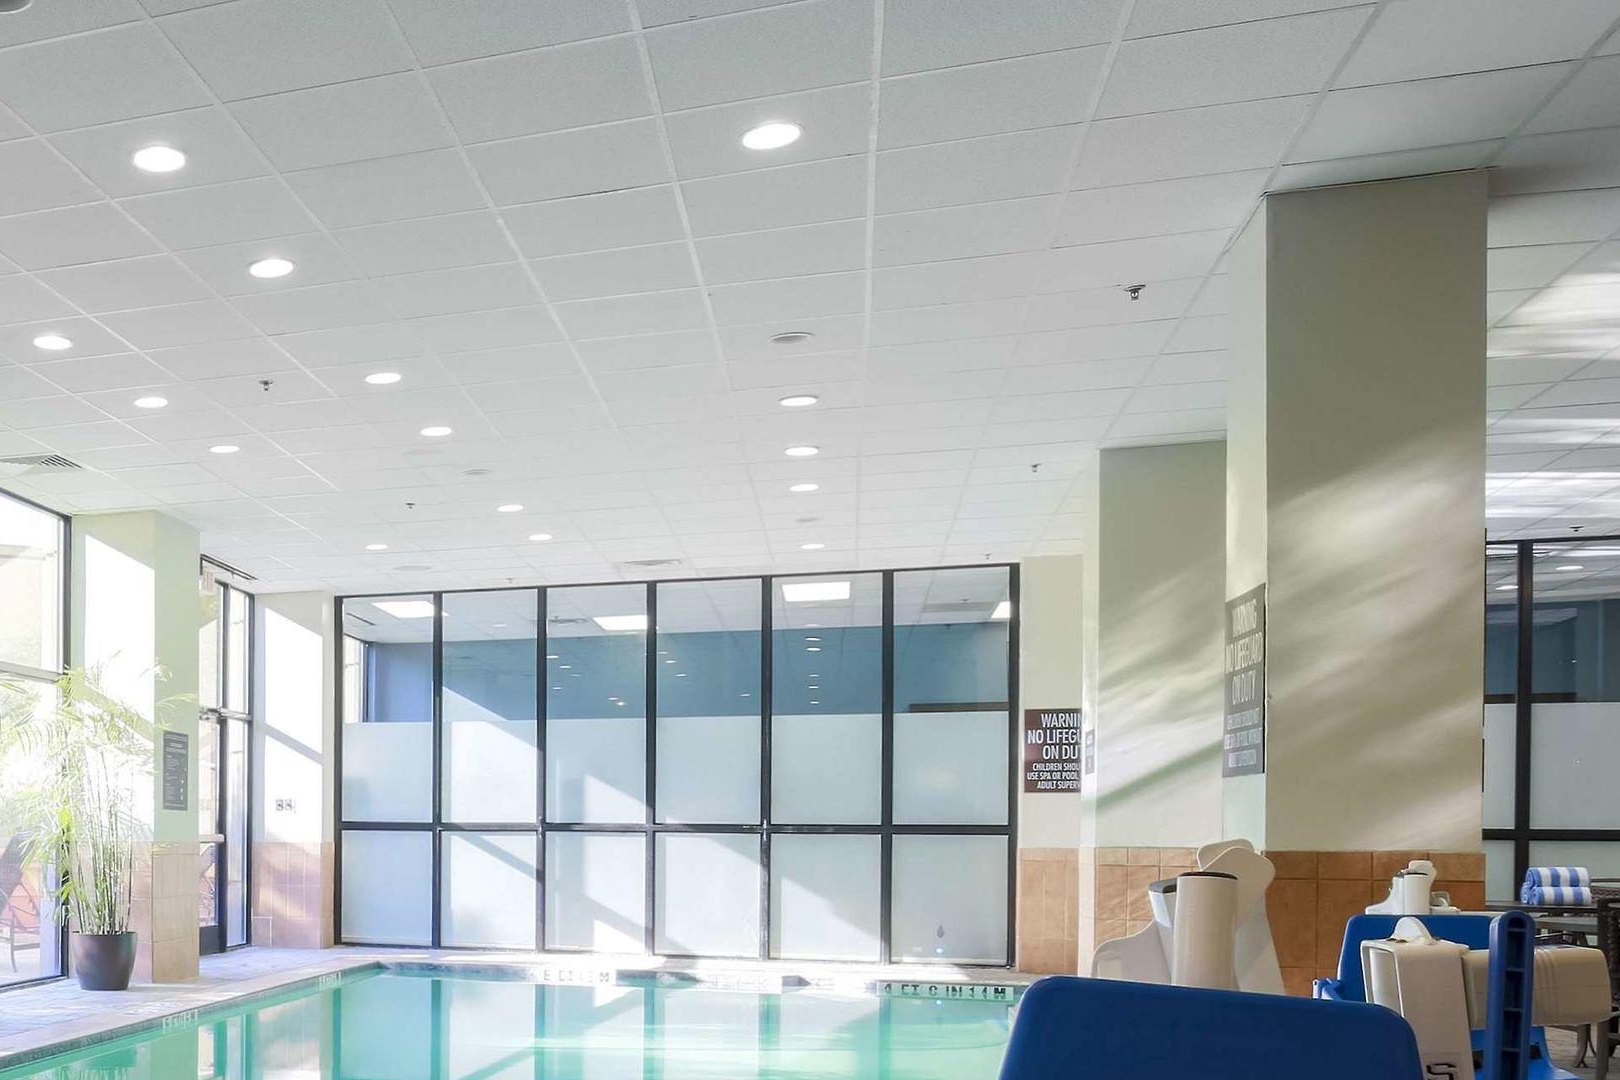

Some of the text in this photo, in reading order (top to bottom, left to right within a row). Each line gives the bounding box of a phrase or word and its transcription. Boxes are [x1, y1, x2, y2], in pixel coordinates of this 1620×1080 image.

[1041, 713, 1081, 727] WARNI
[1027, 730, 1043, 744] NO
[1043, 745, 1081, 760] ON DU
[1033, 763, 1062, 771] CHILDREN
[1027, 772, 1038, 780] USE
[1040, 772, 1051, 780] SPA
